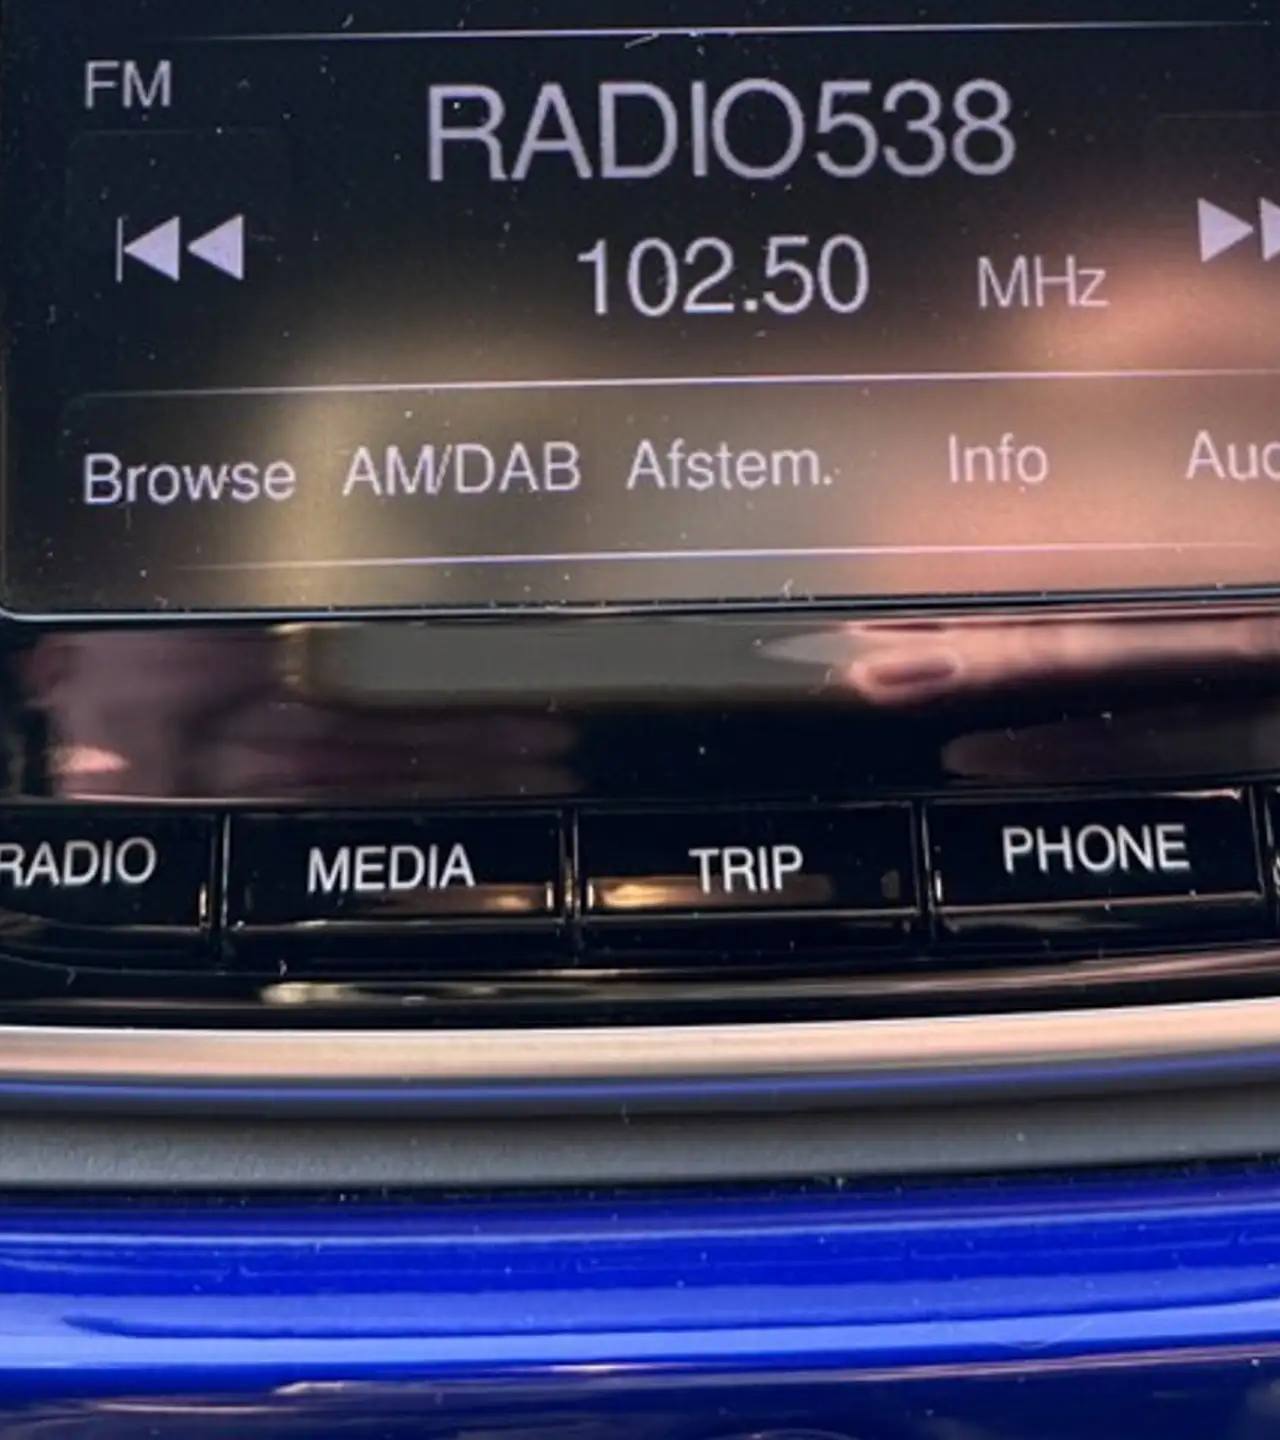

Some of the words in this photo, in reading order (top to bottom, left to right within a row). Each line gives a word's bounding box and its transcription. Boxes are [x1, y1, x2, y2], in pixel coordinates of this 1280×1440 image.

[84, 60, 173, 110] FM
[425, 77, 1017, 182] RADIO538
[576, 234, 870, 318] 102.50
[976, 256, 1111, 310] MHz
[82, 451, 297, 505] Browse
[342, 440, 581, 496] AM/DAB
[626, 436, 834, 491] Afstem.
[948, 434, 1050, 484] Info
[307, 844, 476, 894] MEDIA
[690, 845, 804, 894] TRIP
[1001, 824, 1191, 873] PHONE
